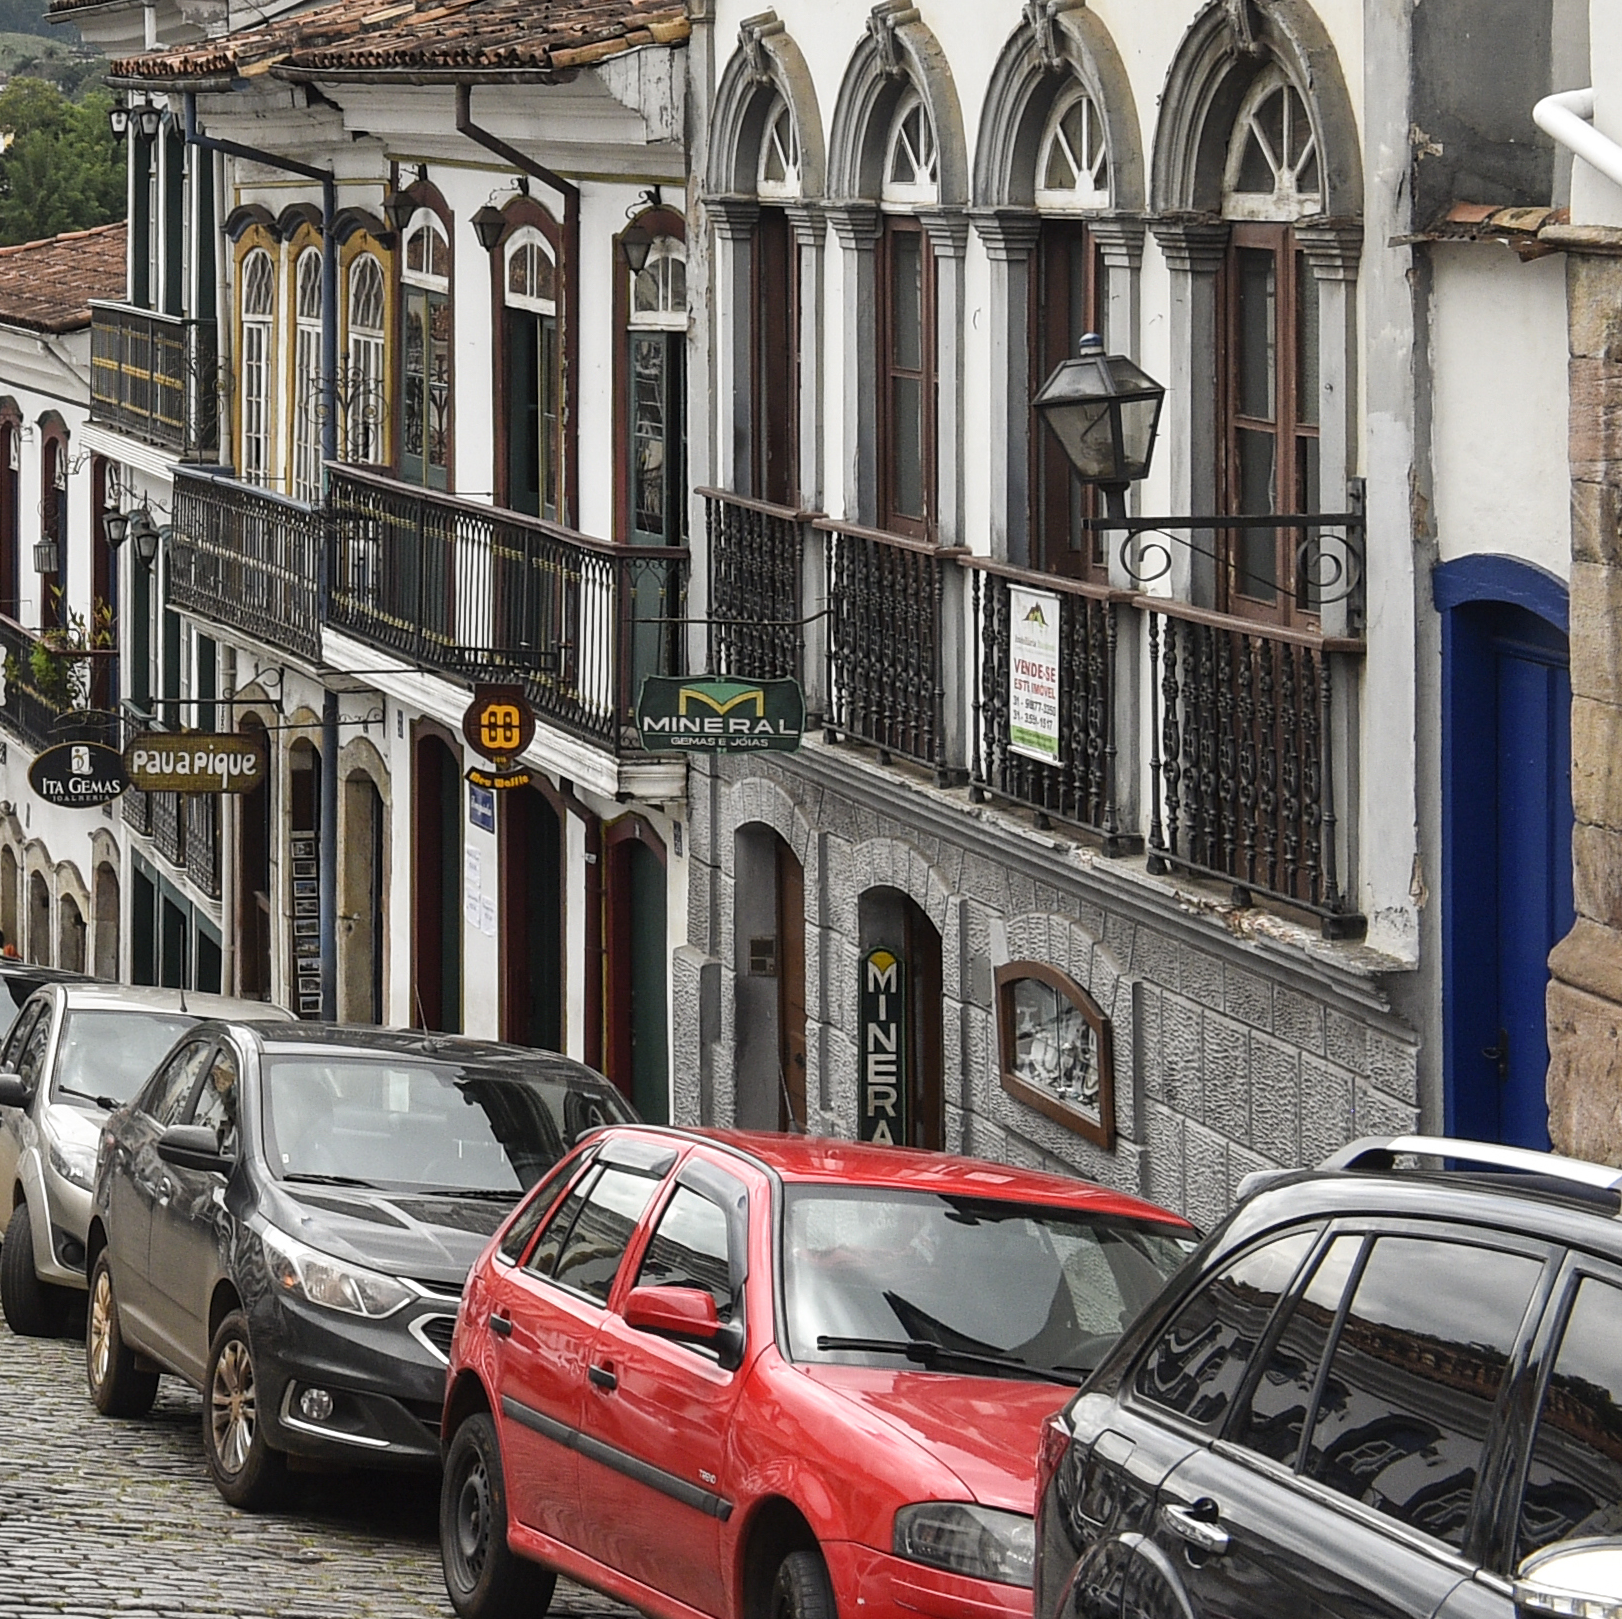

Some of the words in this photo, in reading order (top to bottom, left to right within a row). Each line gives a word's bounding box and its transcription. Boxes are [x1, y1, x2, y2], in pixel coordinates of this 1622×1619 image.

[1013, 658, 1056, 683] VENDE-SE
[1031, 682, 1056, 700] IMÓVEL
[643, 716, 799, 735] MINERAL
[670, 737, 716, 746] GEMAS
[718, 737, 727, 746] E
[730, 735, 769, 747] JÓIAS
[42, 778, 64, 794] ITA
[68, 777, 121, 794] GEMAS
[469, 771, 492, 787] Meu
